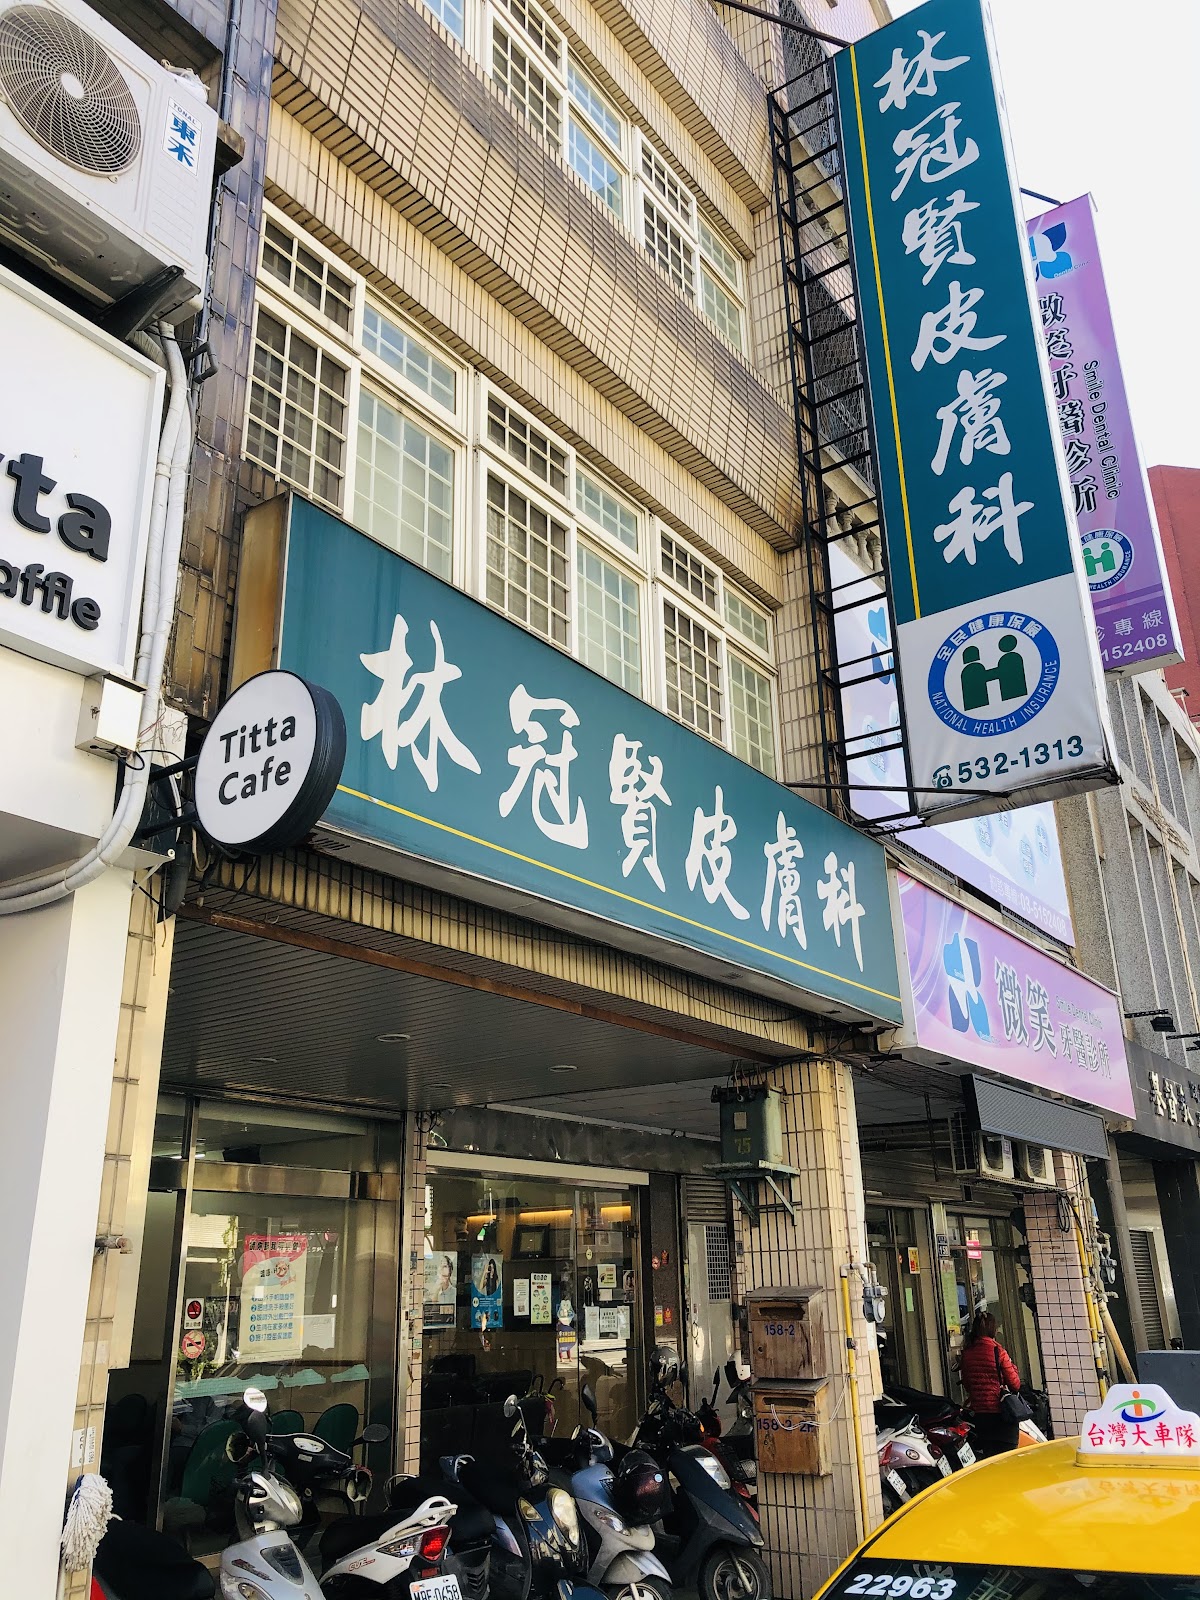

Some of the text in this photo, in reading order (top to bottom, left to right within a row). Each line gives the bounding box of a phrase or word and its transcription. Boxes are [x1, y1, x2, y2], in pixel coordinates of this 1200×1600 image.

[173, 102, 197, 125] TONAL
[873, 30, 1035, 566] 林冠賢皮膚科
[1083, 359, 1124, 500] Smile Dental Clinic
[0, 453, 112, 563] ta
[937, 613, 1043, 662] 全民健康保險
[931, 659, 1058, 735] NATIONAL HEALTH INSURANCE
[220, 715, 296, 764] Titta
[958, 735, 1084, 784] 532-1313
[218, 757, 292, 806] Cafe
[360, 614, 866, 972] 林冠賢皮膚科
[993, 955, 1112, 1080] 微笑 牙醫診所
[764, 1324, 796, 1336] 158-2
[1087, 1421, 1198, 1449] 台灣大車隊
[844, 1573, 957, 1600] 22963
